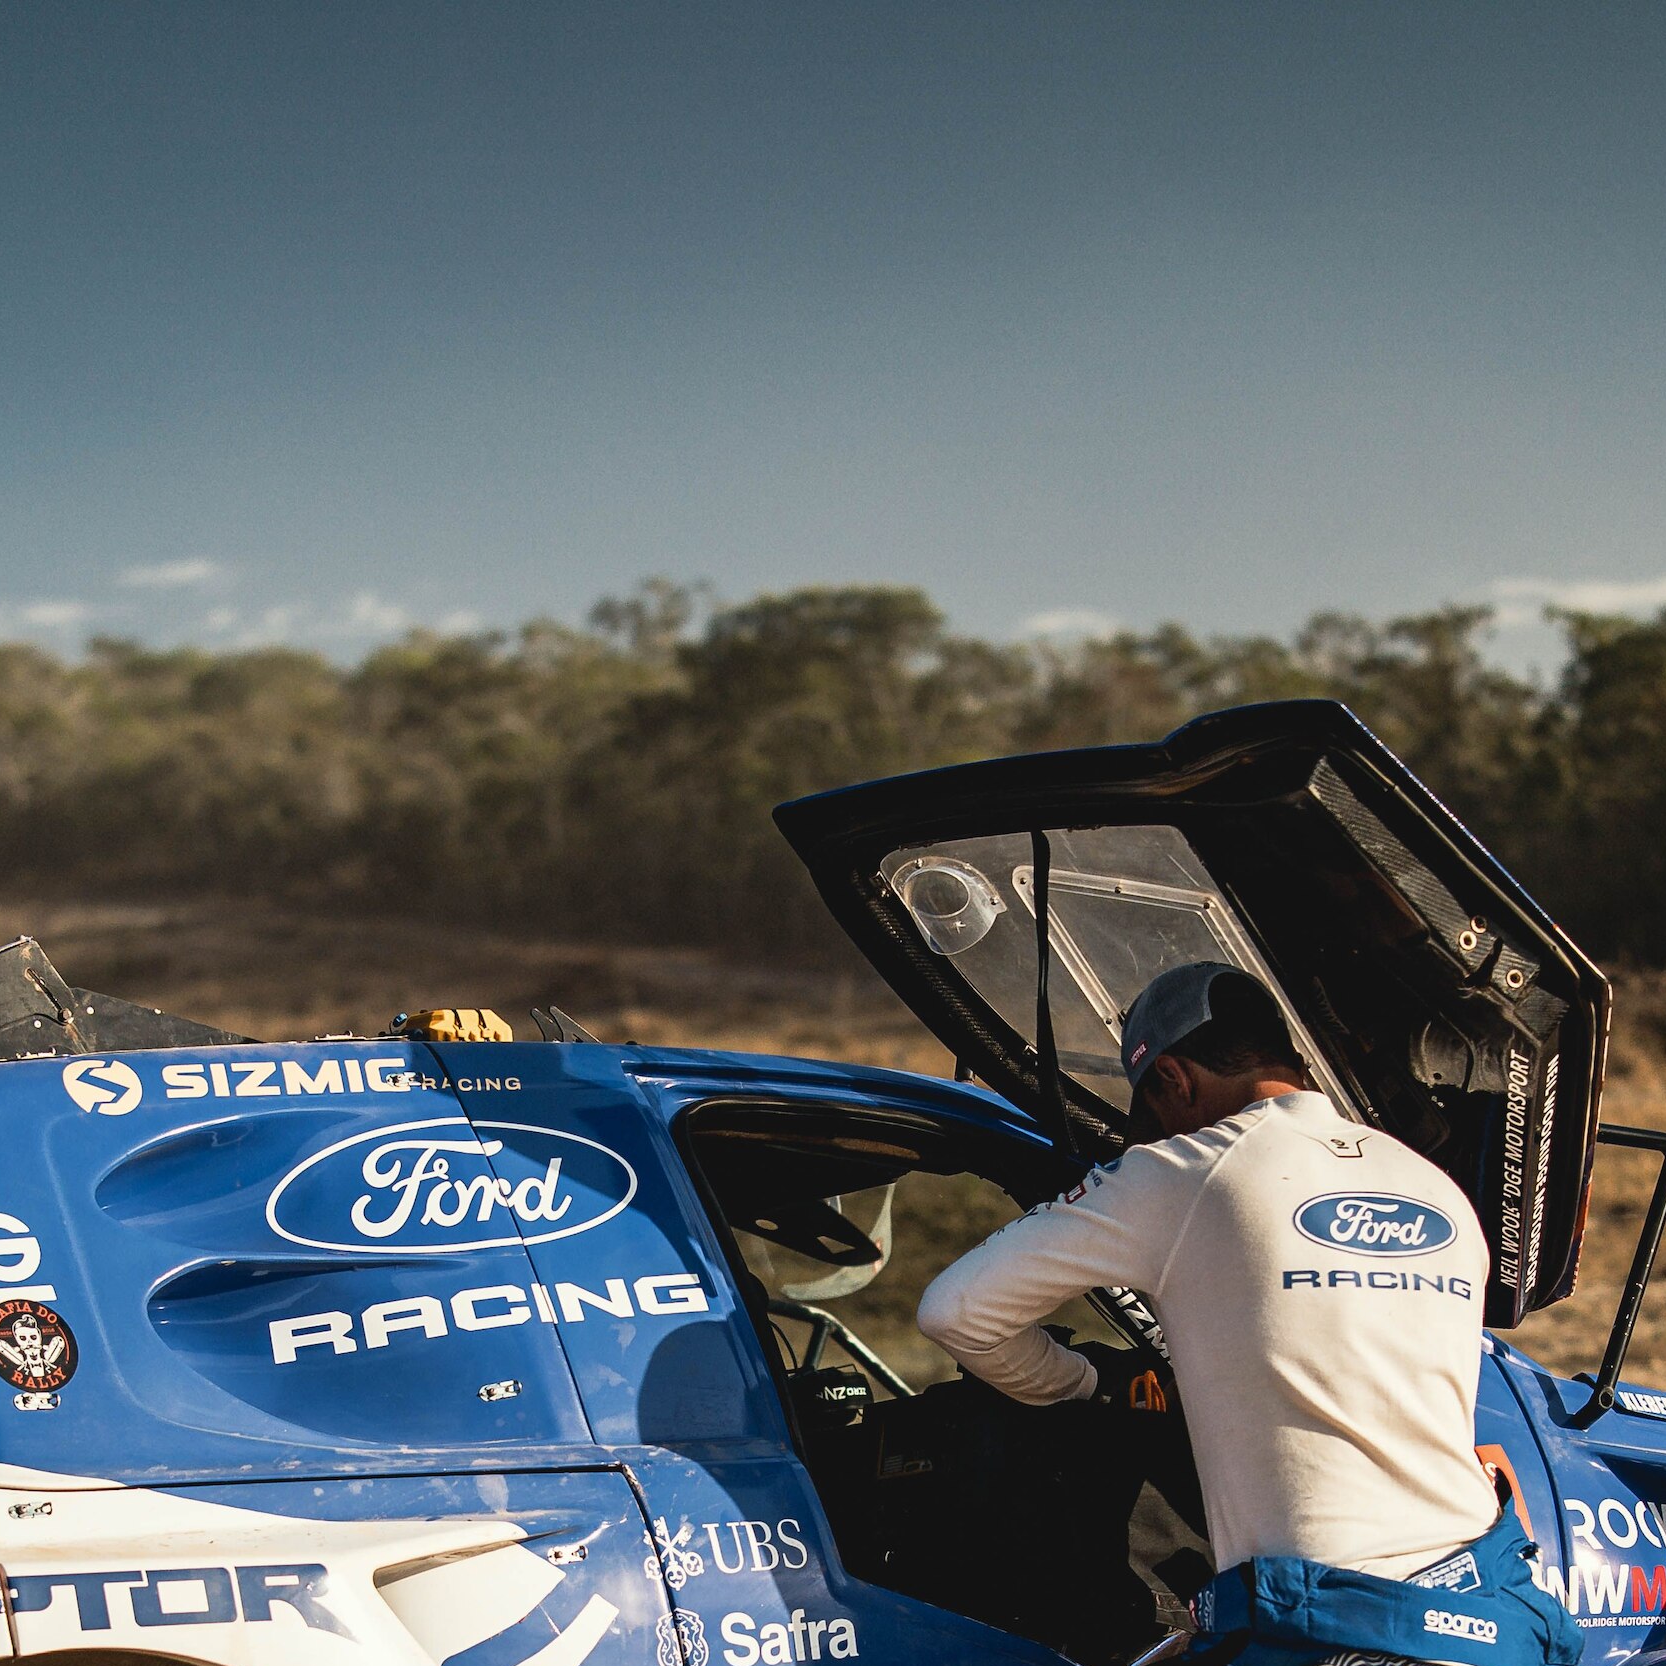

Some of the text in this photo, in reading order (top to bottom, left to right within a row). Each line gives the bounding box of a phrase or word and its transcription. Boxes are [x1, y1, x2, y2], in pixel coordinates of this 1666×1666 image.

[421, 1076, 522, 1092] RACING
[1505, 1049, 1530, 1164] MOTORSPORT
[351, 1139, 573, 1239] Ford
[1525, 1053, 1560, 1294] NEIL WOOLRIDGE MOTORSPORT
[1330, 1203, 1428, 1248] Ford
[1282, 1269, 1472, 1301] RACING
[1500, 1256, 1519, 1289] NEIL
[36, 1305, 59, 1326] DO
[269, 1273, 710, 1365] RACING
[10, 1366, 68, 1390] RALLY
[703, 1518, 809, 1574] UBS
[1424, 1609, 1498, 1642] sparco
[1573, 1616, 1617, 1628] OOLRIDGE
